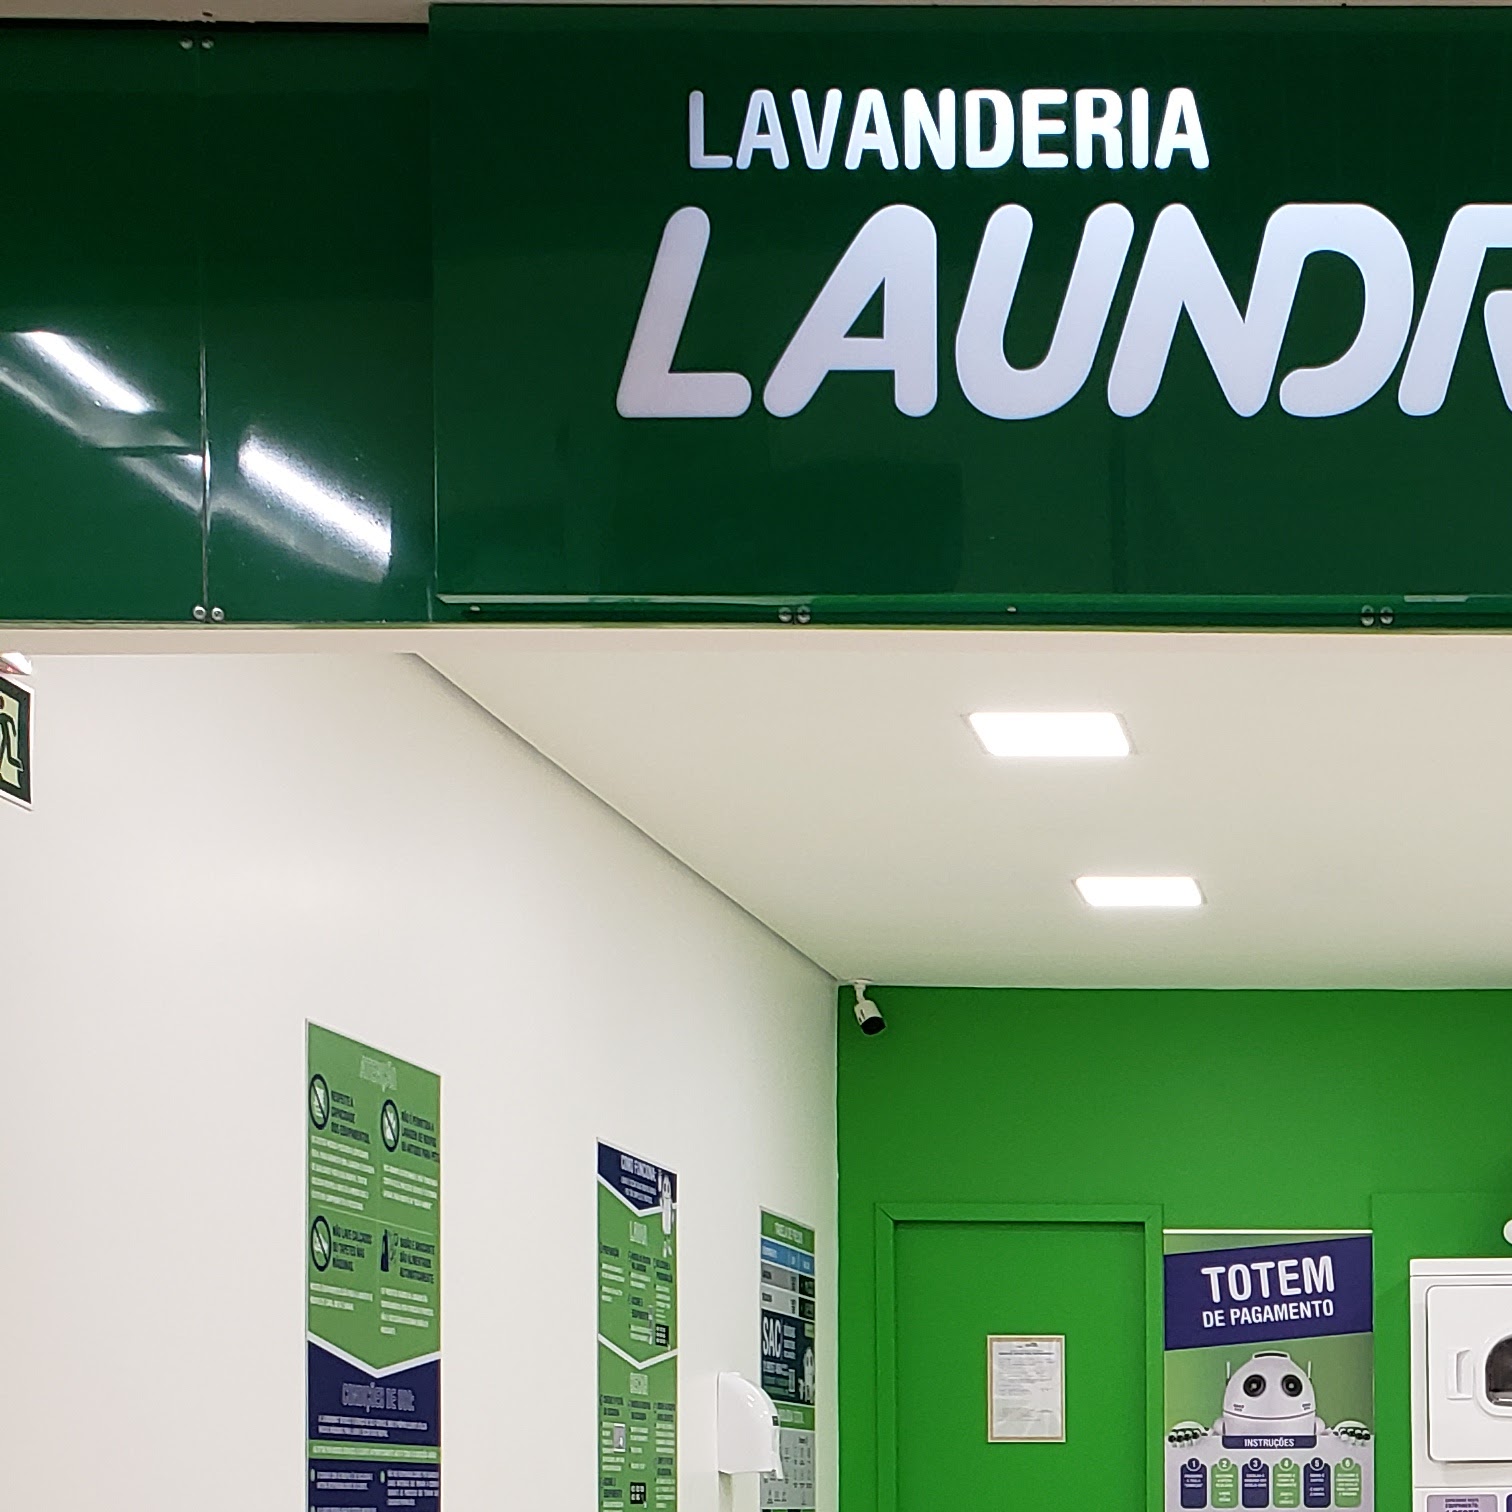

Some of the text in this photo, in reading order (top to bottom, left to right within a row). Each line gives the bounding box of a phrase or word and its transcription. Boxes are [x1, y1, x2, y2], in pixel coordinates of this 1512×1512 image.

[689, 87, 1209, 171] LAVANDERIA
[1201, 1255, 1335, 1303] TOTEM
[1202, 1298, 1334, 1328] DE PAGAMENTO
[762, 1316, 781, 1358] SAC
[1243, 1436, 1295, 1450] INSTRUÇÕES
